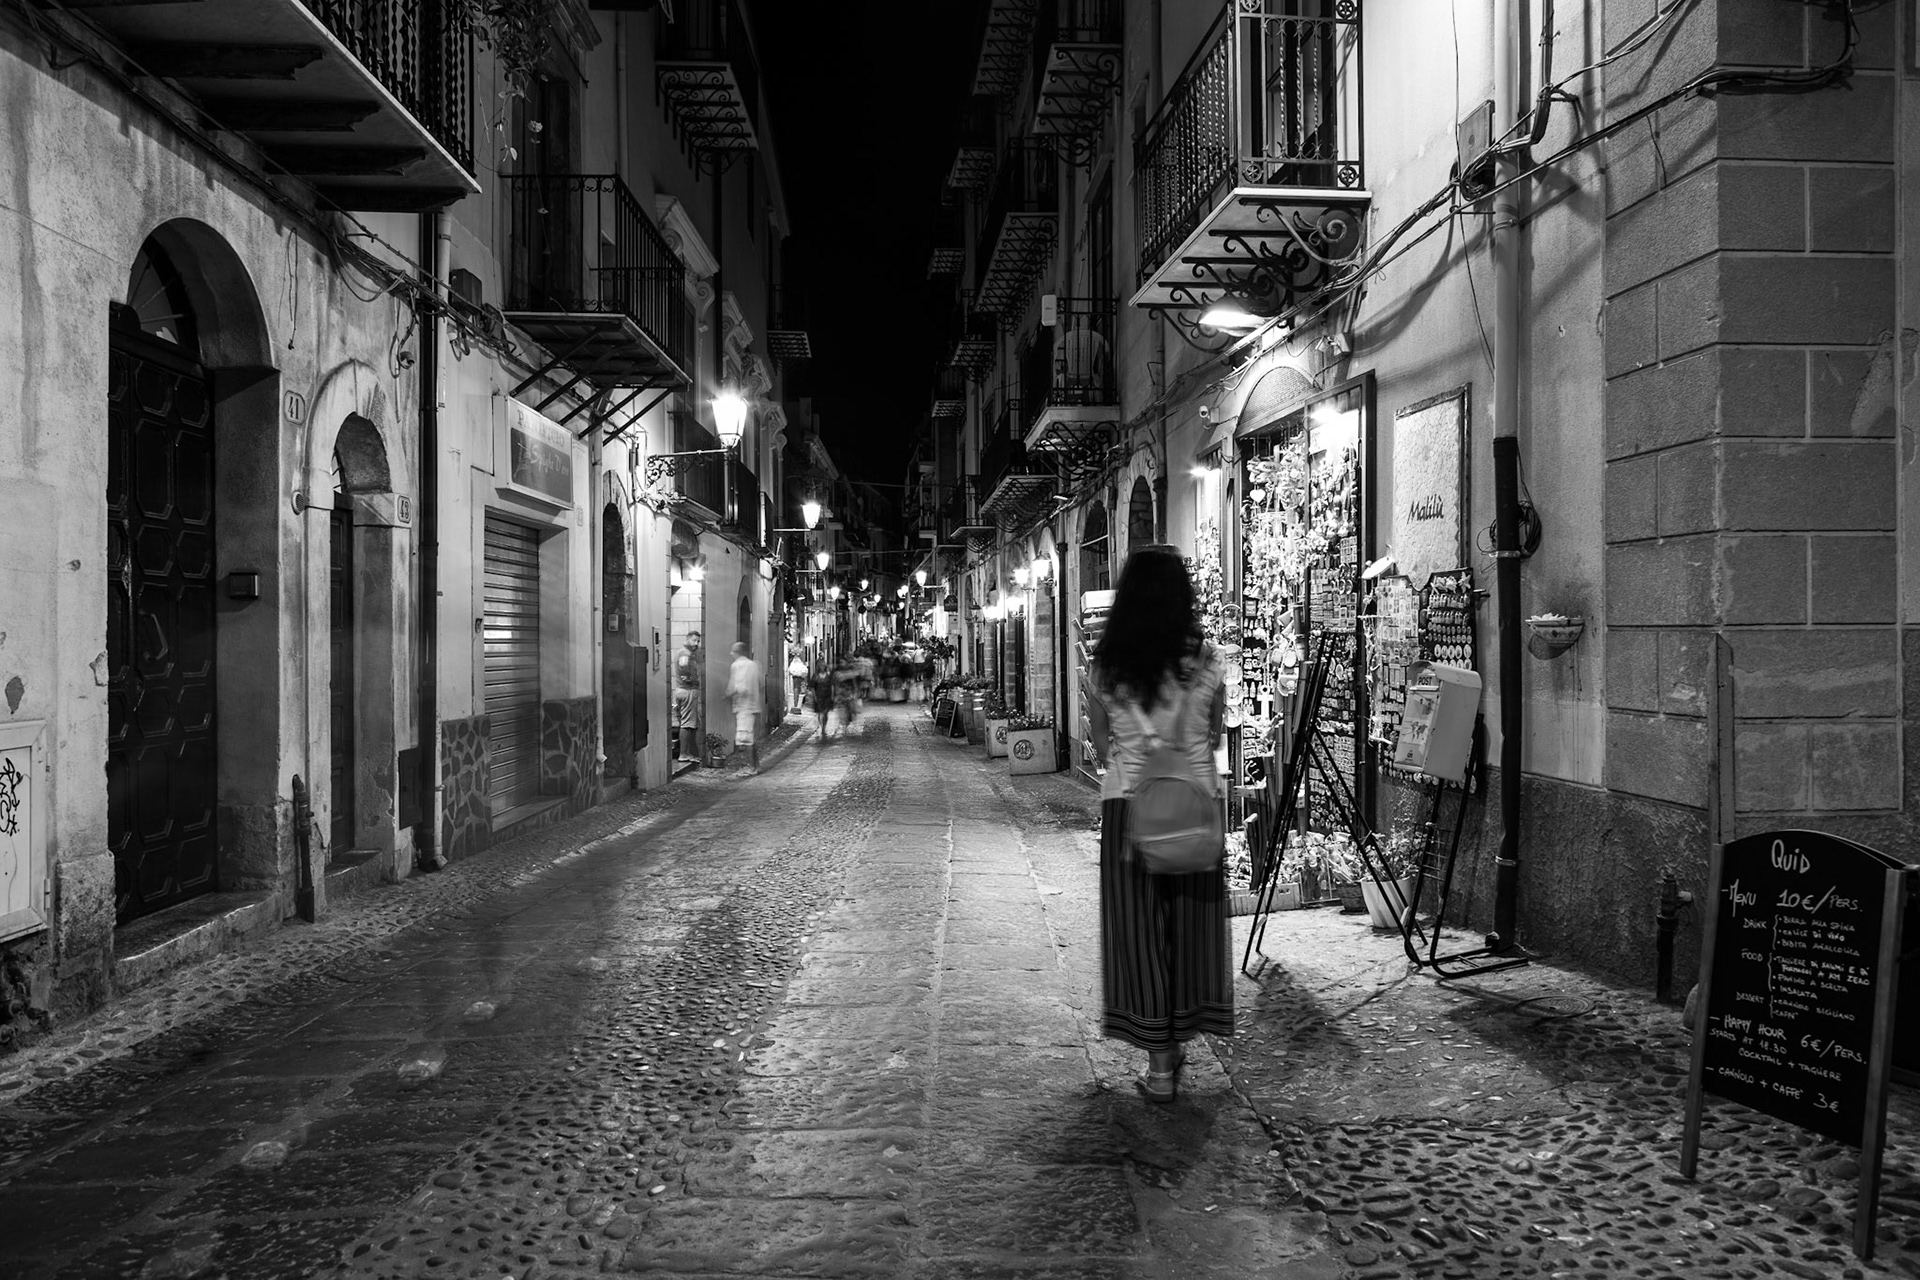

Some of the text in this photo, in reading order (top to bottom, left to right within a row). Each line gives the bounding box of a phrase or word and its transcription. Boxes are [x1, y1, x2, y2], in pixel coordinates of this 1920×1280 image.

[288, 395, 299, 420] 41
[399, 499, 410, 520] 43
[1417, 676, 1433, 686] POST
[1741, 948, 1763, 962] FOOD
[1848, 965, 1855, 974] E
[1809, 979, 1817, 987] A
[1846, 975, 1870, 986] ZERO
[1780, 985, 1818, 999] INSALATA
[1724, 1014, 1752, 1034] HAPPY
[1758, 1023, 1787, 1041] HOUR
[1742, 1036, 1754, 1045] AT
[1738, 1047, 1783, 1066] COCKTAIL
